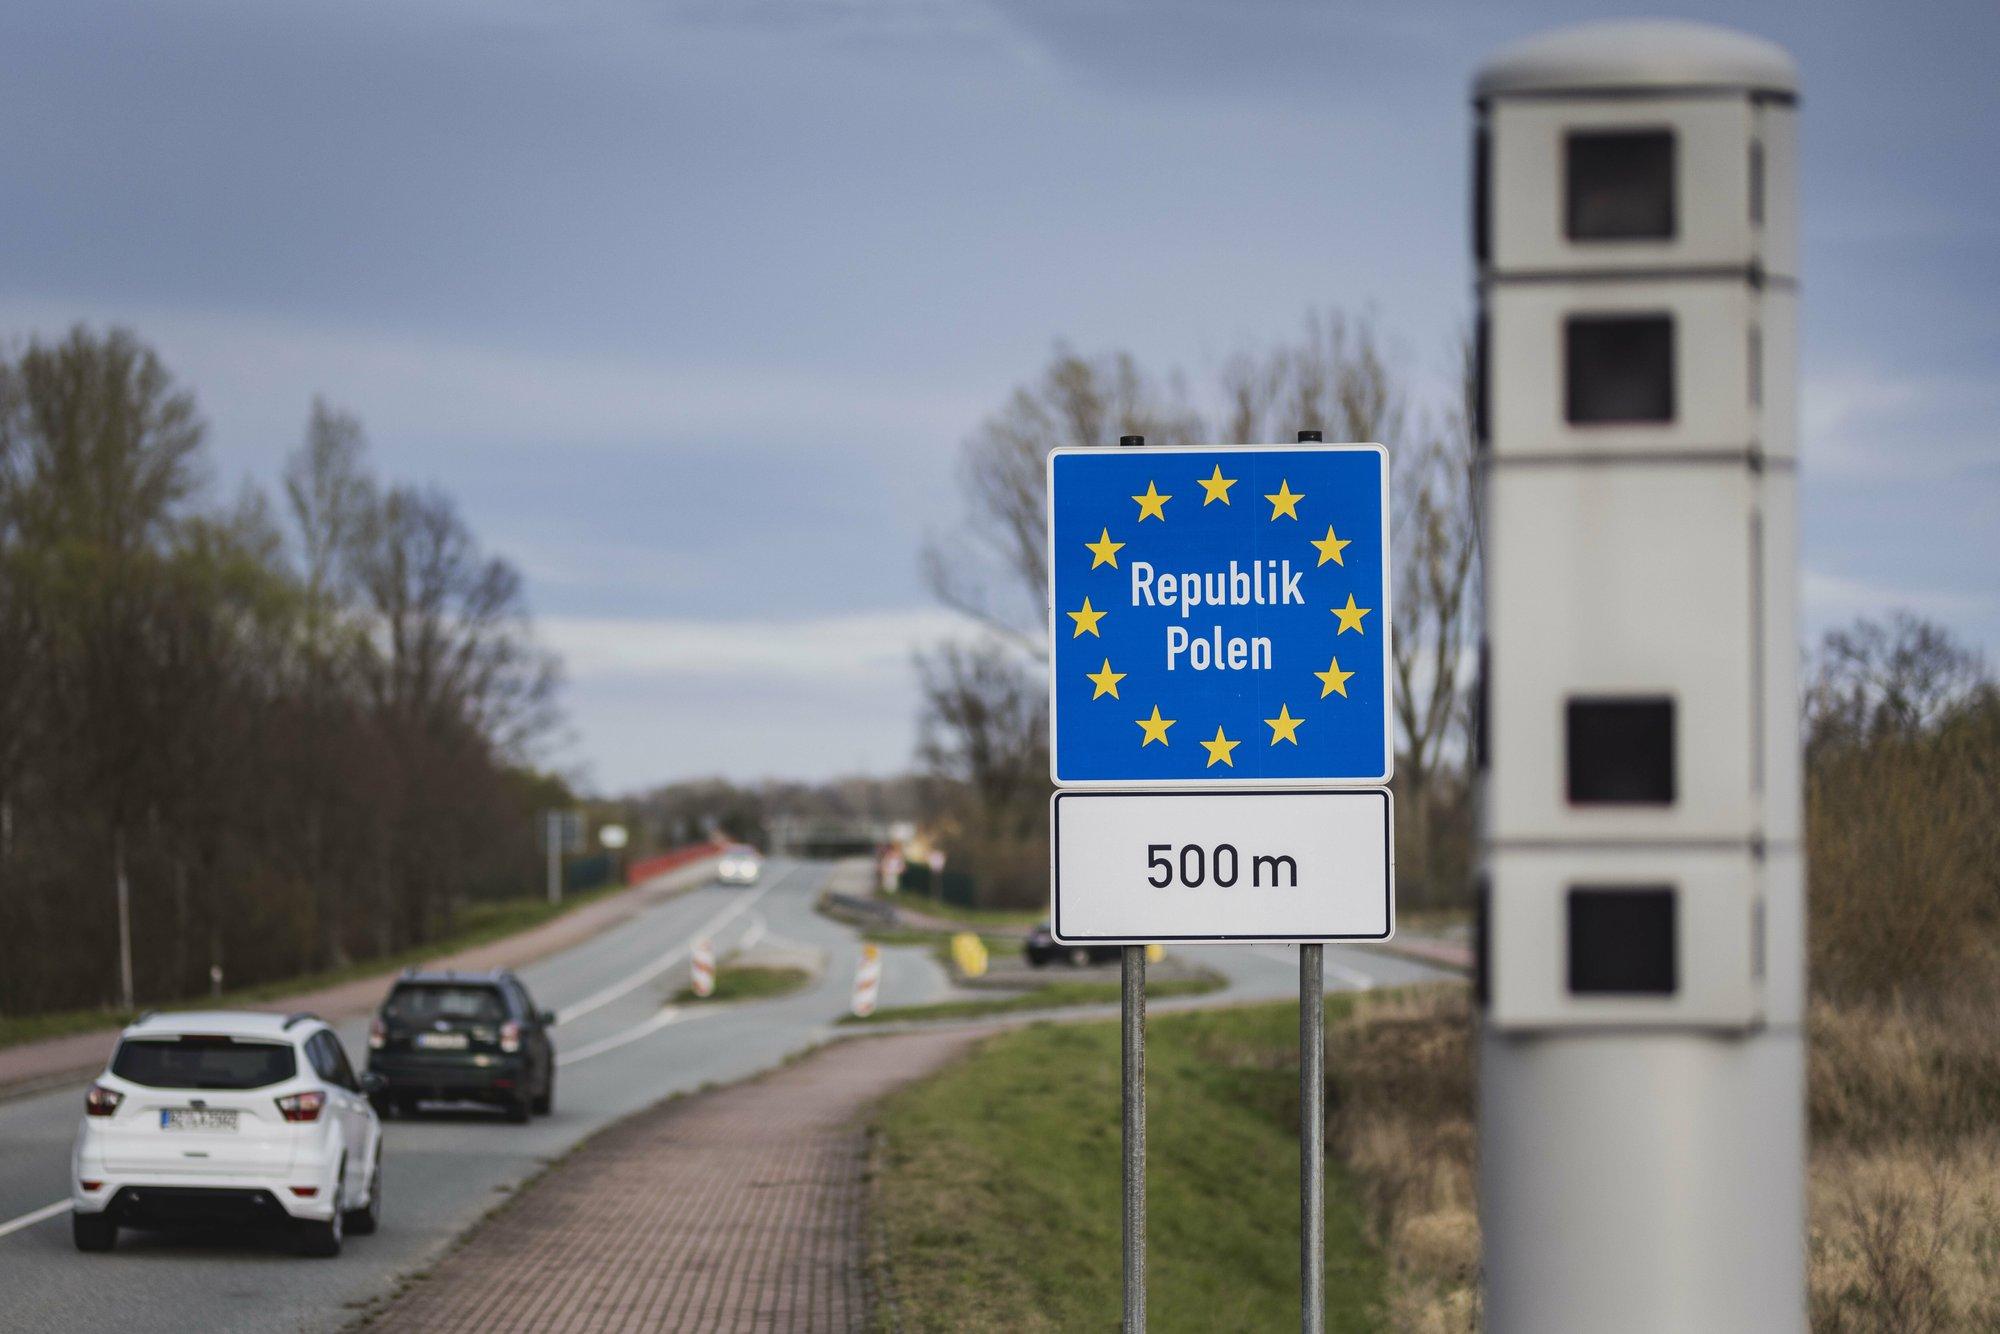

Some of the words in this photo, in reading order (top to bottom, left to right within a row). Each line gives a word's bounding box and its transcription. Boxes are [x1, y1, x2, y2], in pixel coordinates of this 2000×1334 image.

[1131, 559, 1305, 618] Republik
[1167, 625, 1272, 671] Polen
[1147, 843, 1239, 889] 500
[1252, 855, 1298, 888] m
